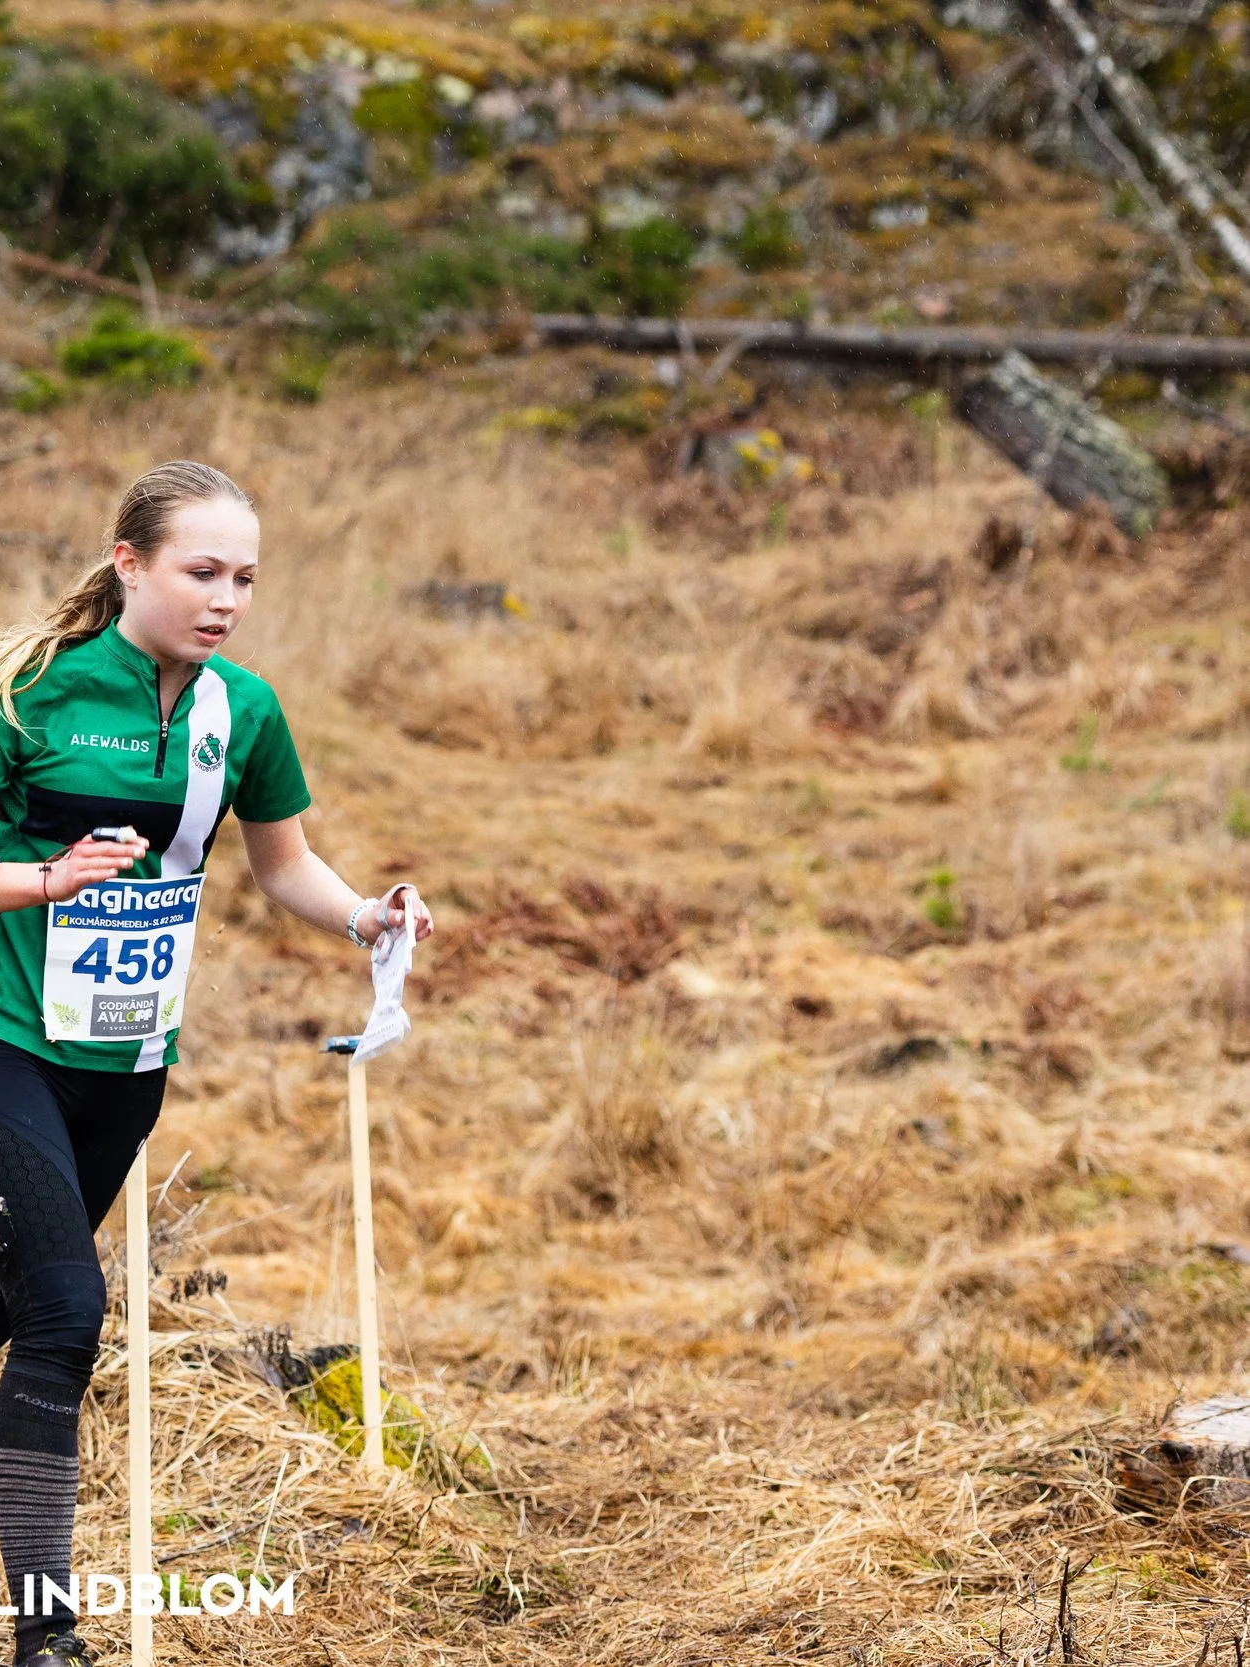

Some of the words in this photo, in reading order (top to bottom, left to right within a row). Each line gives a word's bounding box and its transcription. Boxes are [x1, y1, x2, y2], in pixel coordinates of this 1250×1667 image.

[70, 733, 150, 753] ALEWALDS
[69, 916, 149, 928] KOLMÅRDSMEDELN
[169, 914, 184, 923] 2026
[72, 934, 175, 985] 458
[98, 999, 155, 1011] GODKÄNDA
[96, 1008, 153, 1023] AVLOPP
